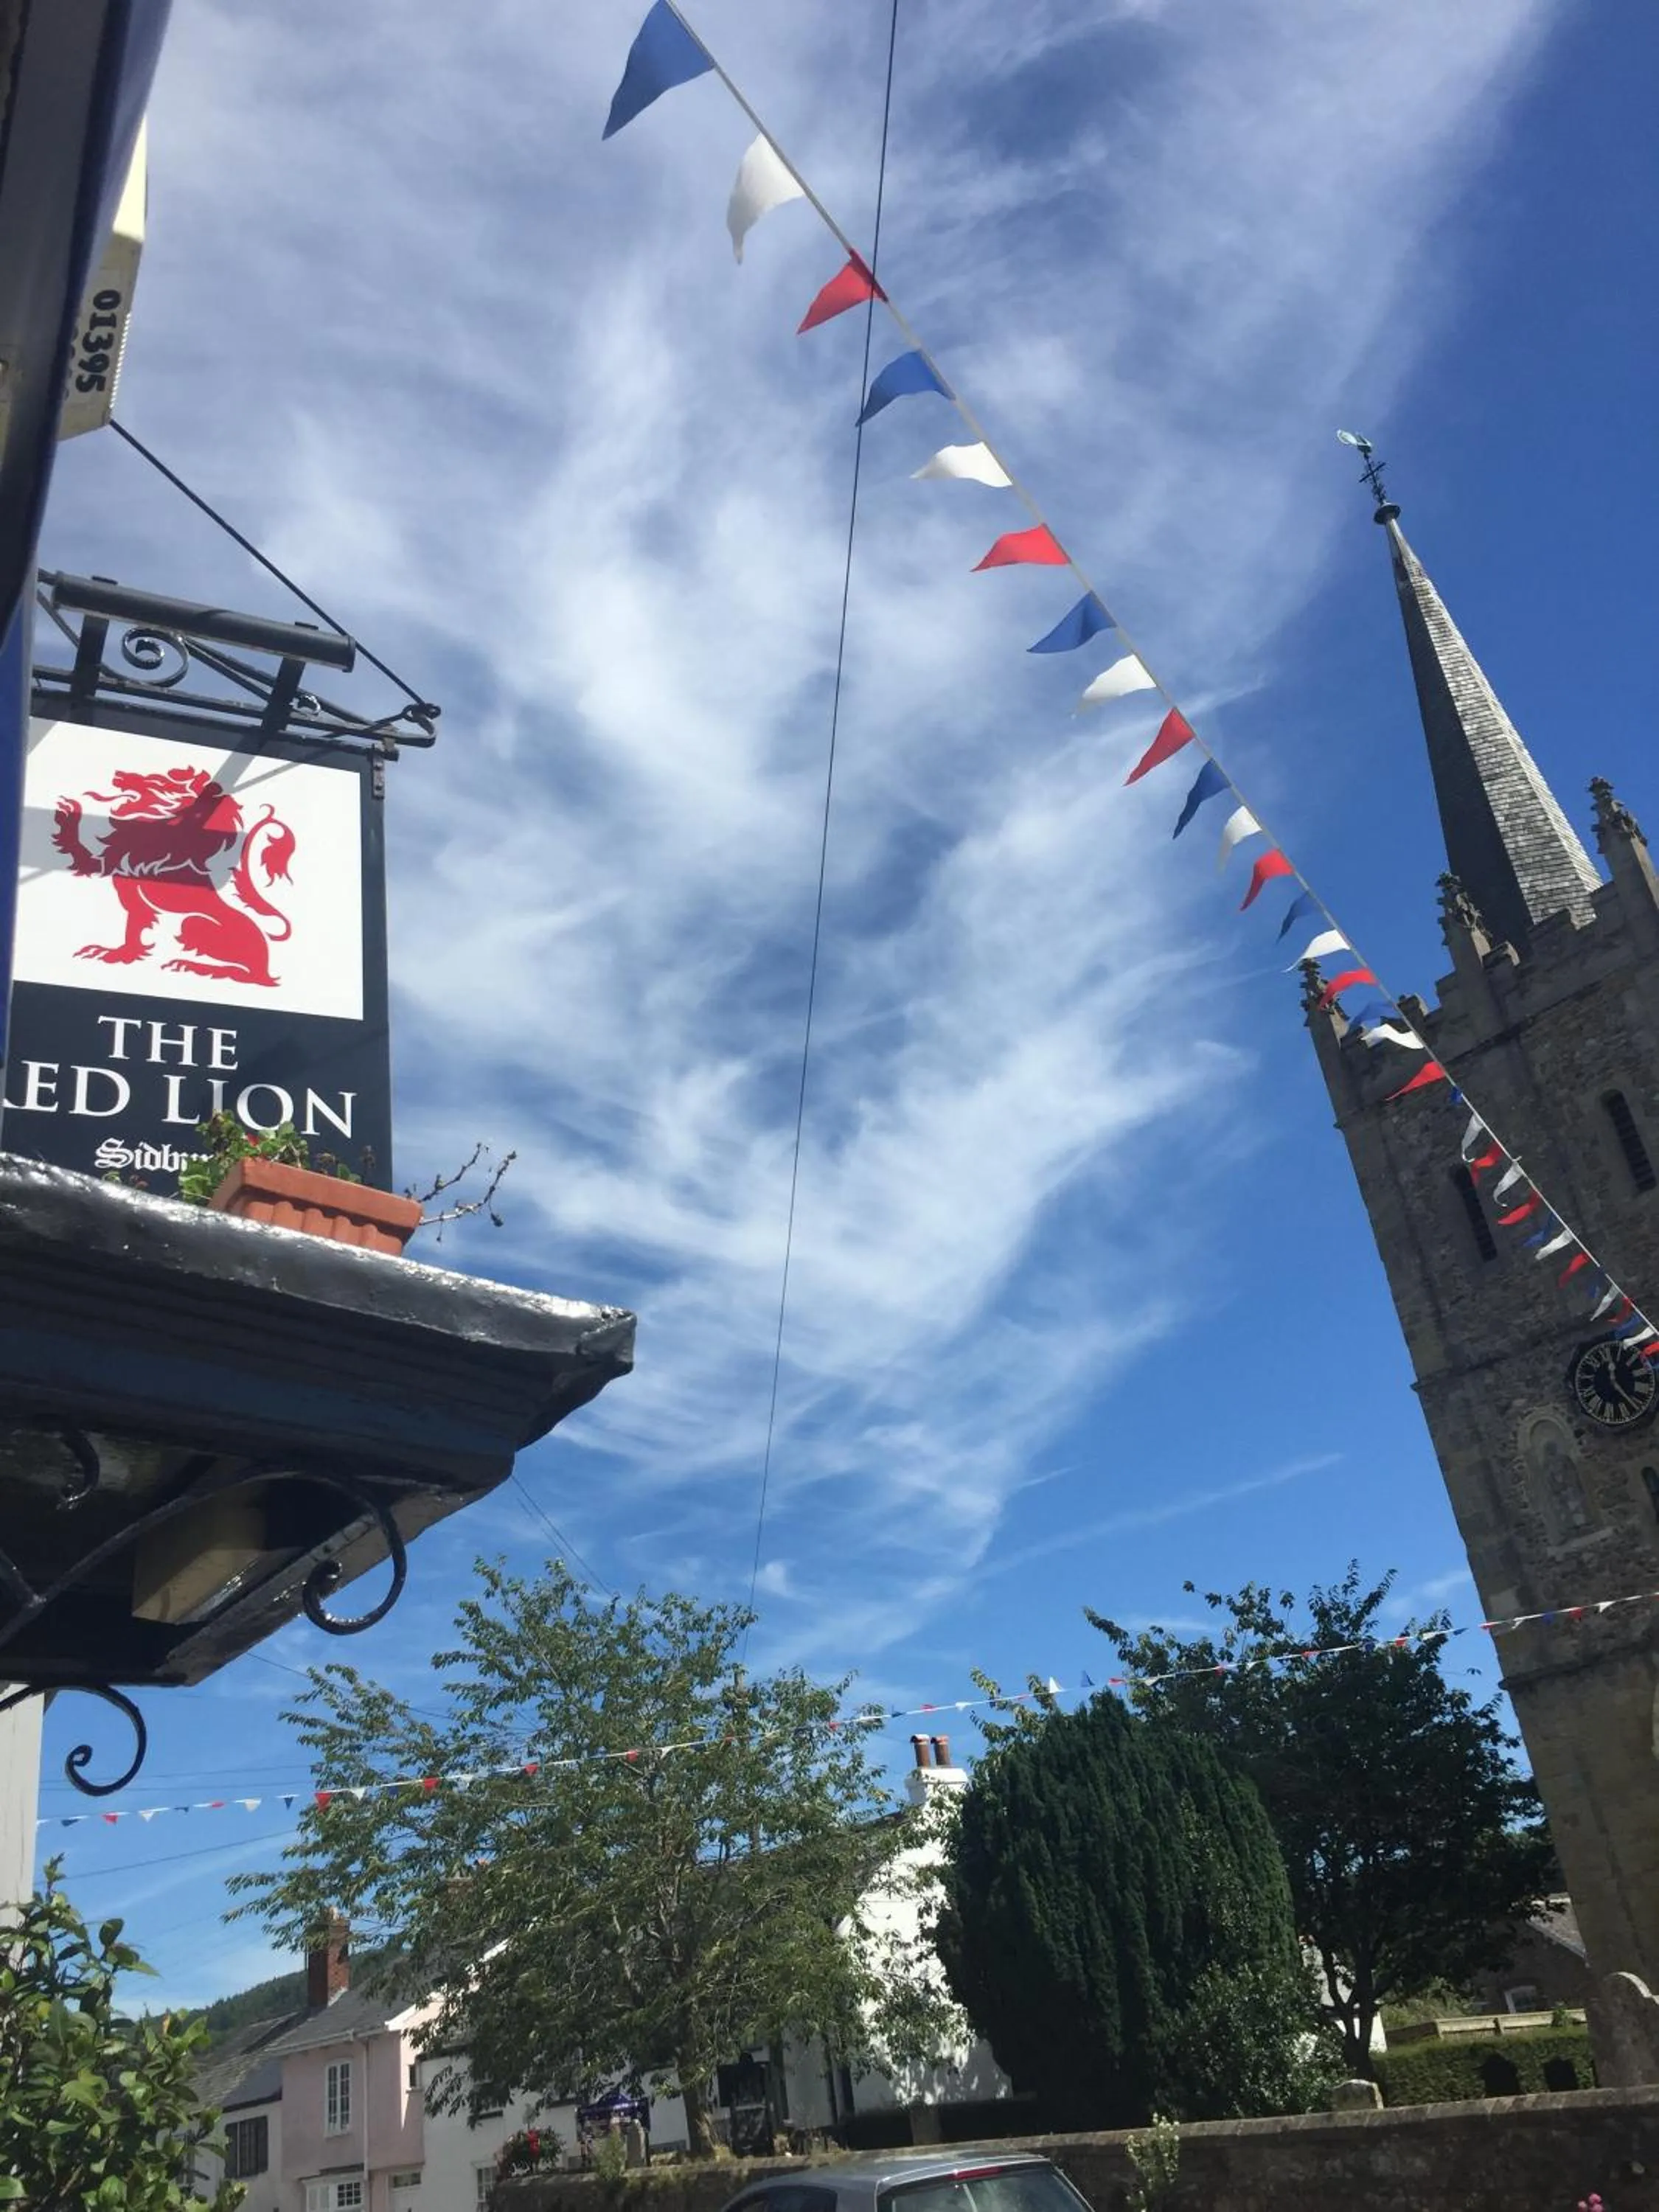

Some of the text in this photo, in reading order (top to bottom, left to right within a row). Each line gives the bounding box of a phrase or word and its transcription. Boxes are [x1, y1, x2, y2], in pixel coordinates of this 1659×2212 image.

[75, 289, 121, 392] 01395
[97, 1015, 239, 1070] THE
[2, 1060, 358, 1139] ED LION
